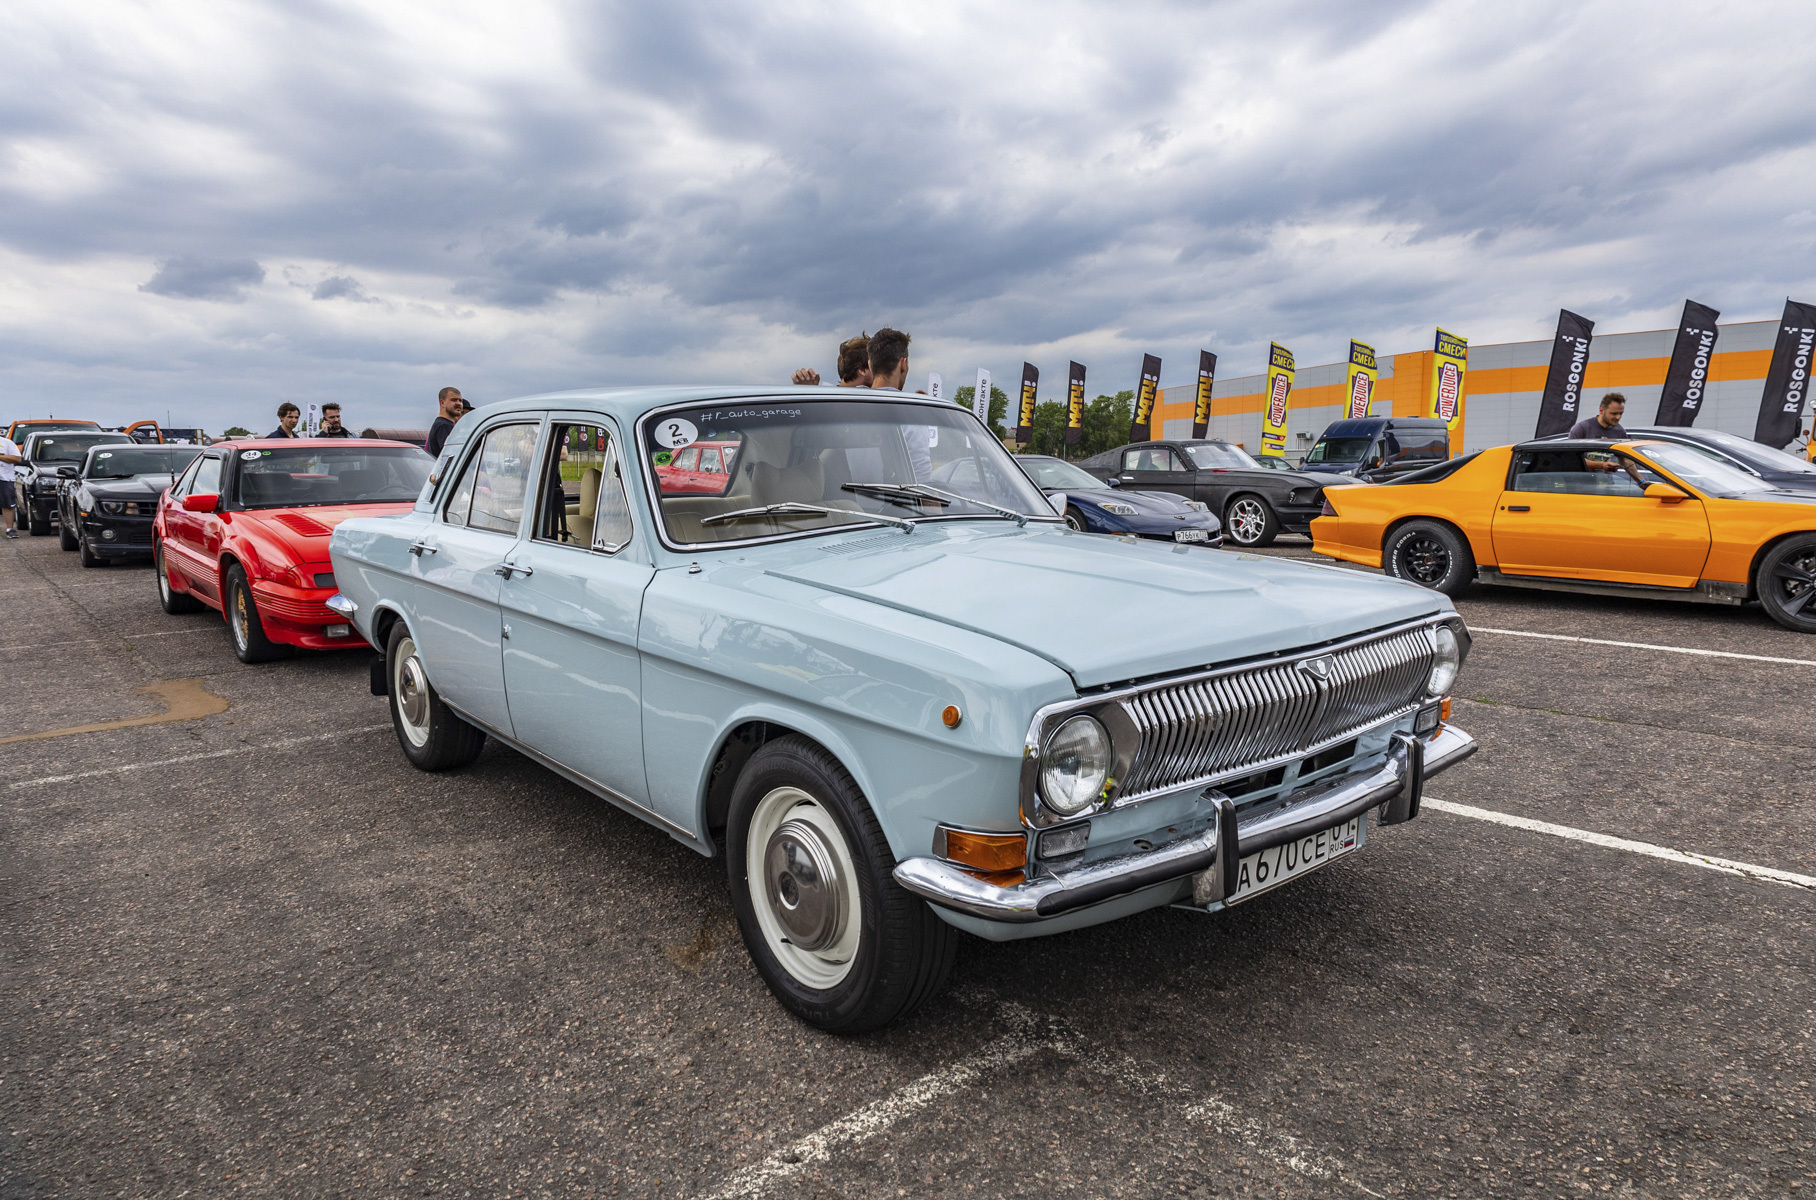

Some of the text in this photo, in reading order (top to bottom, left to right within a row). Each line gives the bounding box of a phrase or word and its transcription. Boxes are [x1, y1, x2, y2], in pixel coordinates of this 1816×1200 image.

[1441, 365, 1456, 418] POWERJUICE
[1563, 337, 1588, 412] ROSGONKI
[1682, 329, 1714, 410] ROSGONKI
[1783, 328, 1815, 413] ROSGONKI
[1272, 377, 1286, 424] POWERJUICE
[1354, 375, 1368, 418] OWERJUICE
[668, 424, 682, 437] 2
[1392, 531, 1416, 578] COOPER COBRA
[1330, 841, 1344, 853] RUS
